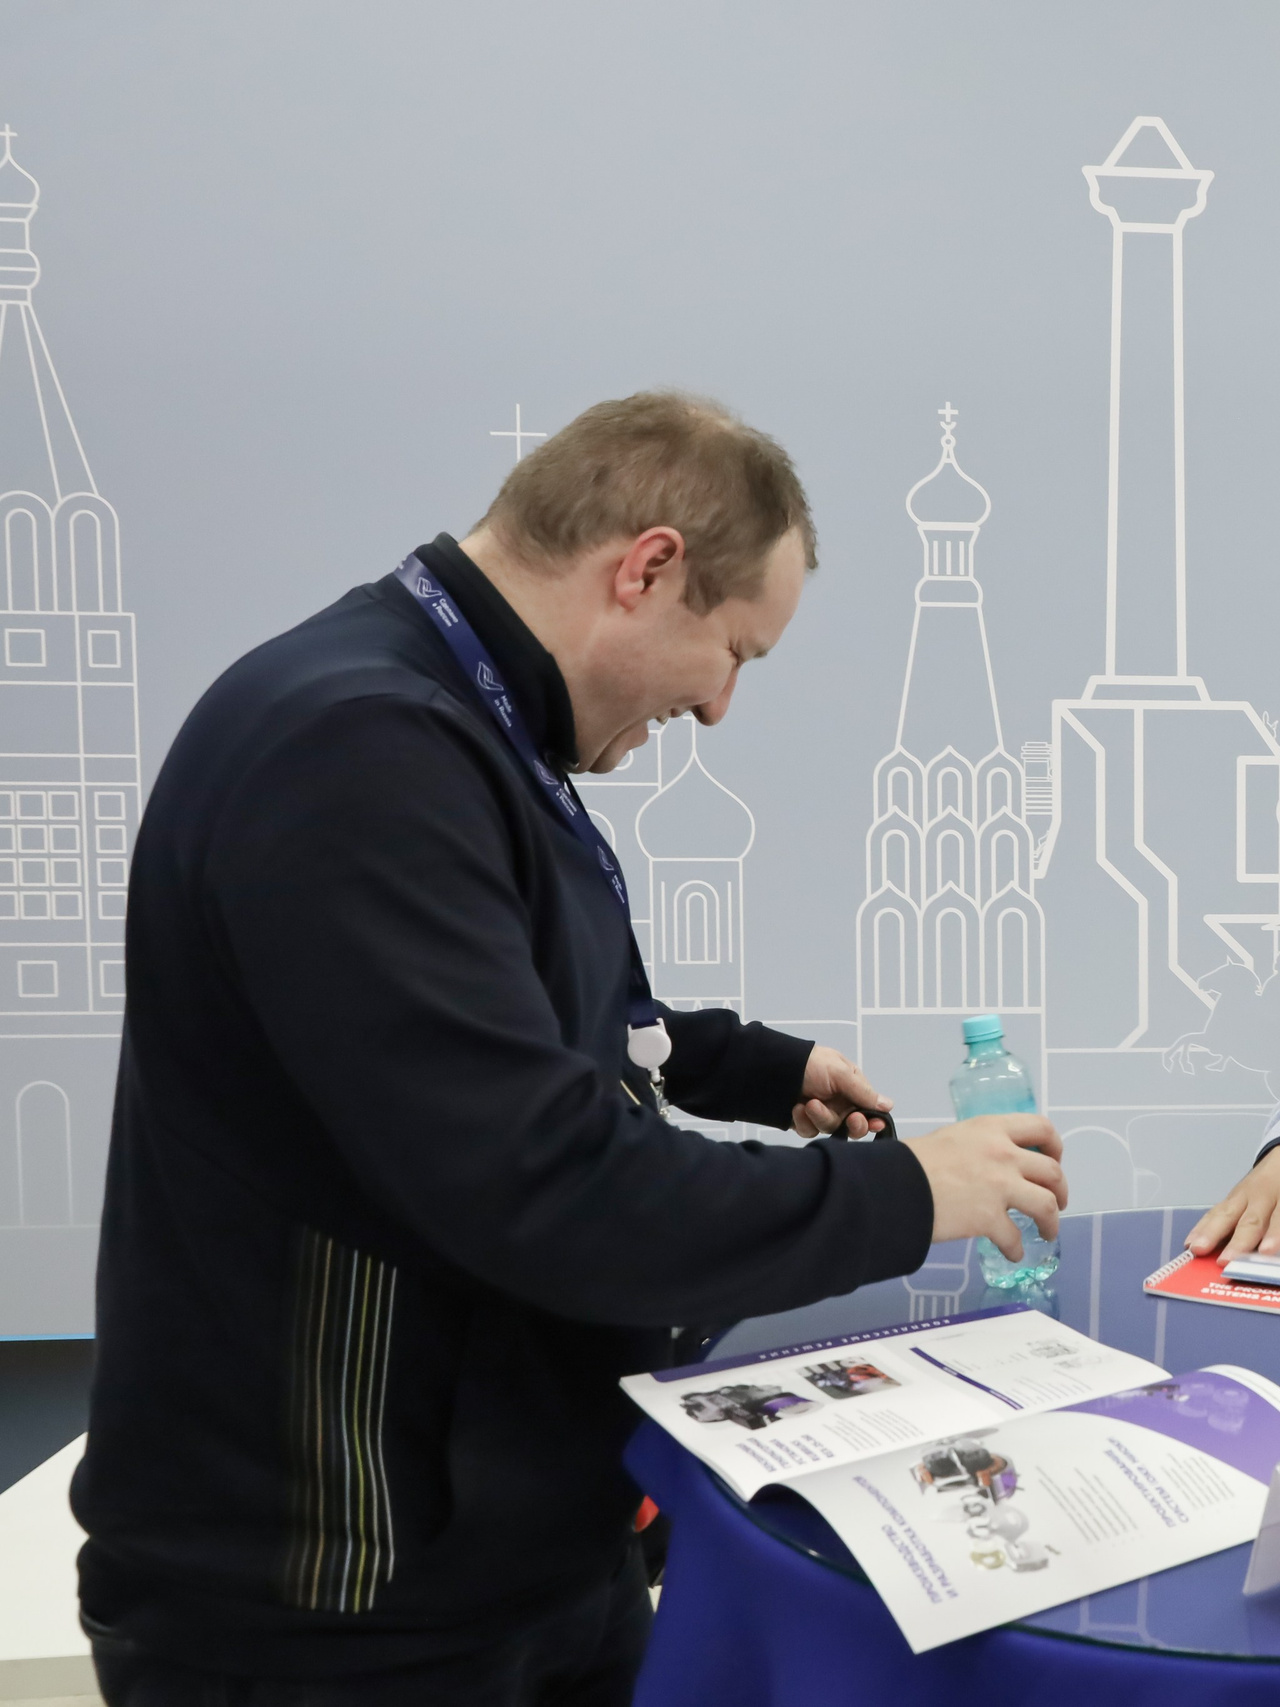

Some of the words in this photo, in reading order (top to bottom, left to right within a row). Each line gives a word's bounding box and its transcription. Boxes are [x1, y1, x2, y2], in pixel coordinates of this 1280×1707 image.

[500, 694, 513, 714] Made
[498, 705, 513, 728] Russia
[1200, 1287, 1260, 1301] SYSTEMS
[1208, 1281, 1234, 1291] THE
[841, 1318, 951, 1345] КОМПЛЕКСНЫЕ
[758, 1340, 834, 1361] РЕШЕНИЯ
